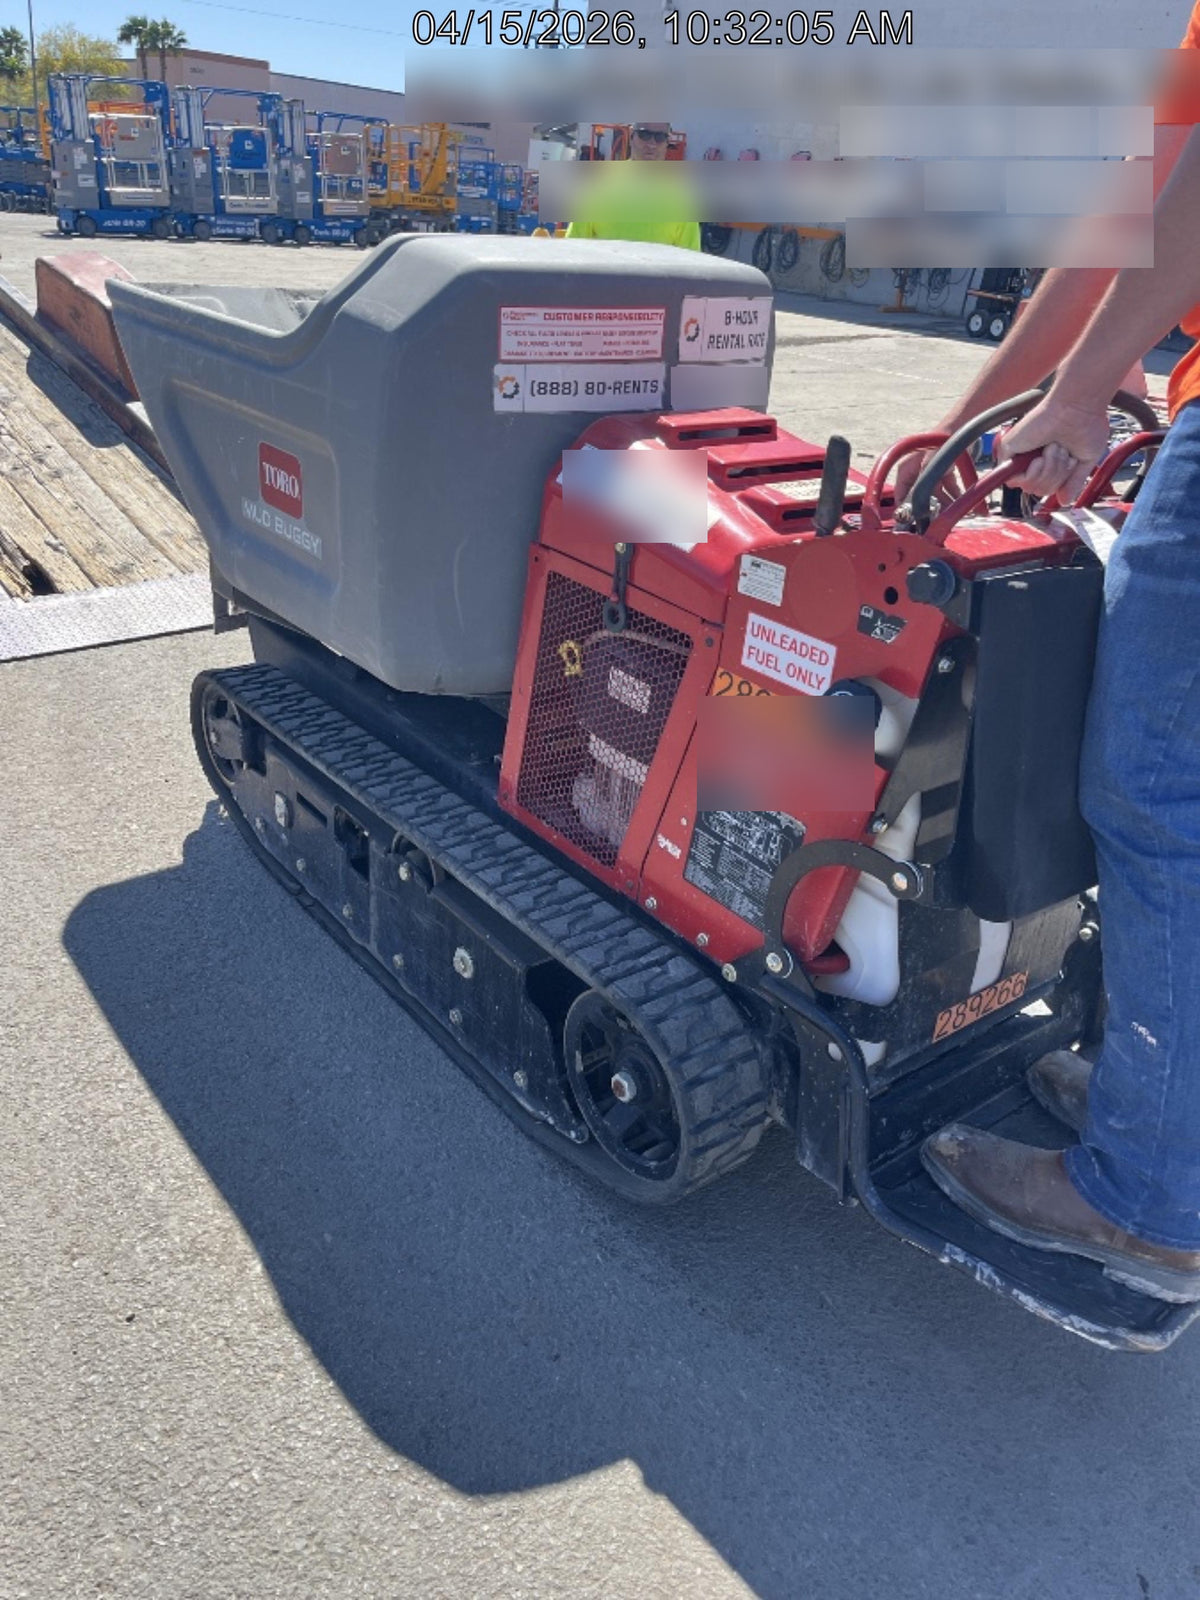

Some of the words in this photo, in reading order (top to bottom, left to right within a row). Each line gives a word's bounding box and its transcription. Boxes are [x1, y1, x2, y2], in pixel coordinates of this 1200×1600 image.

[707, 333, 745, 350] RENTAL
[530, 379, 579, 397] (888)
[584, 379, 659, 396] 80-RENTS
[262, 461, 300, 498] TORO
[274, 515, 321, 558] BUGGY
[751, 621, 830, 667] UNLEADED
[746, 645, 782, 673] FUEL
[785, 662, 827, 691] ONLY
[935, 973, 1027, 1039] 289266
